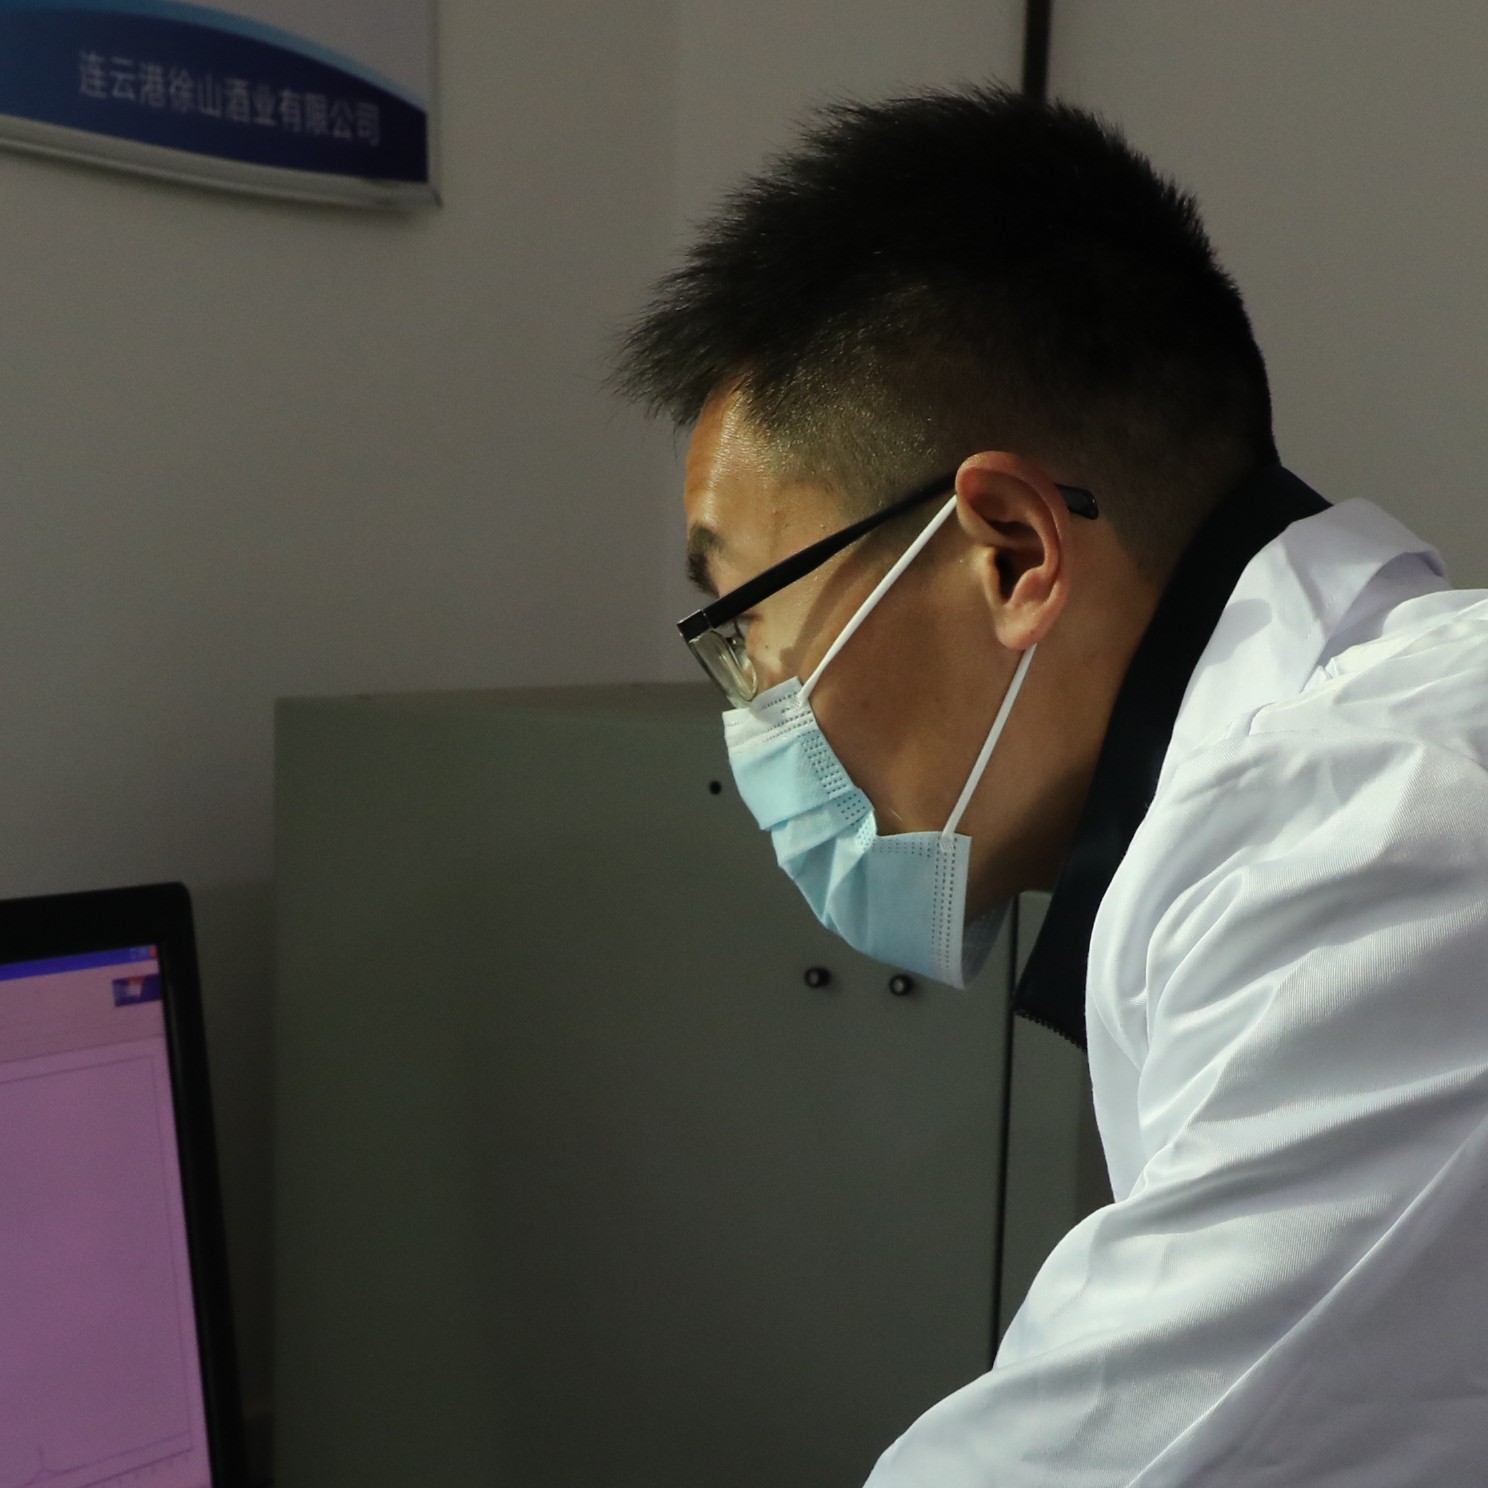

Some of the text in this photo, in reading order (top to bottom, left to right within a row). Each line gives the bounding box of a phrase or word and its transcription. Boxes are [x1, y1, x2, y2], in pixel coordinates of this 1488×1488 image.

[77, 49, 383, 148] 连云港徐山酒业有限公司
